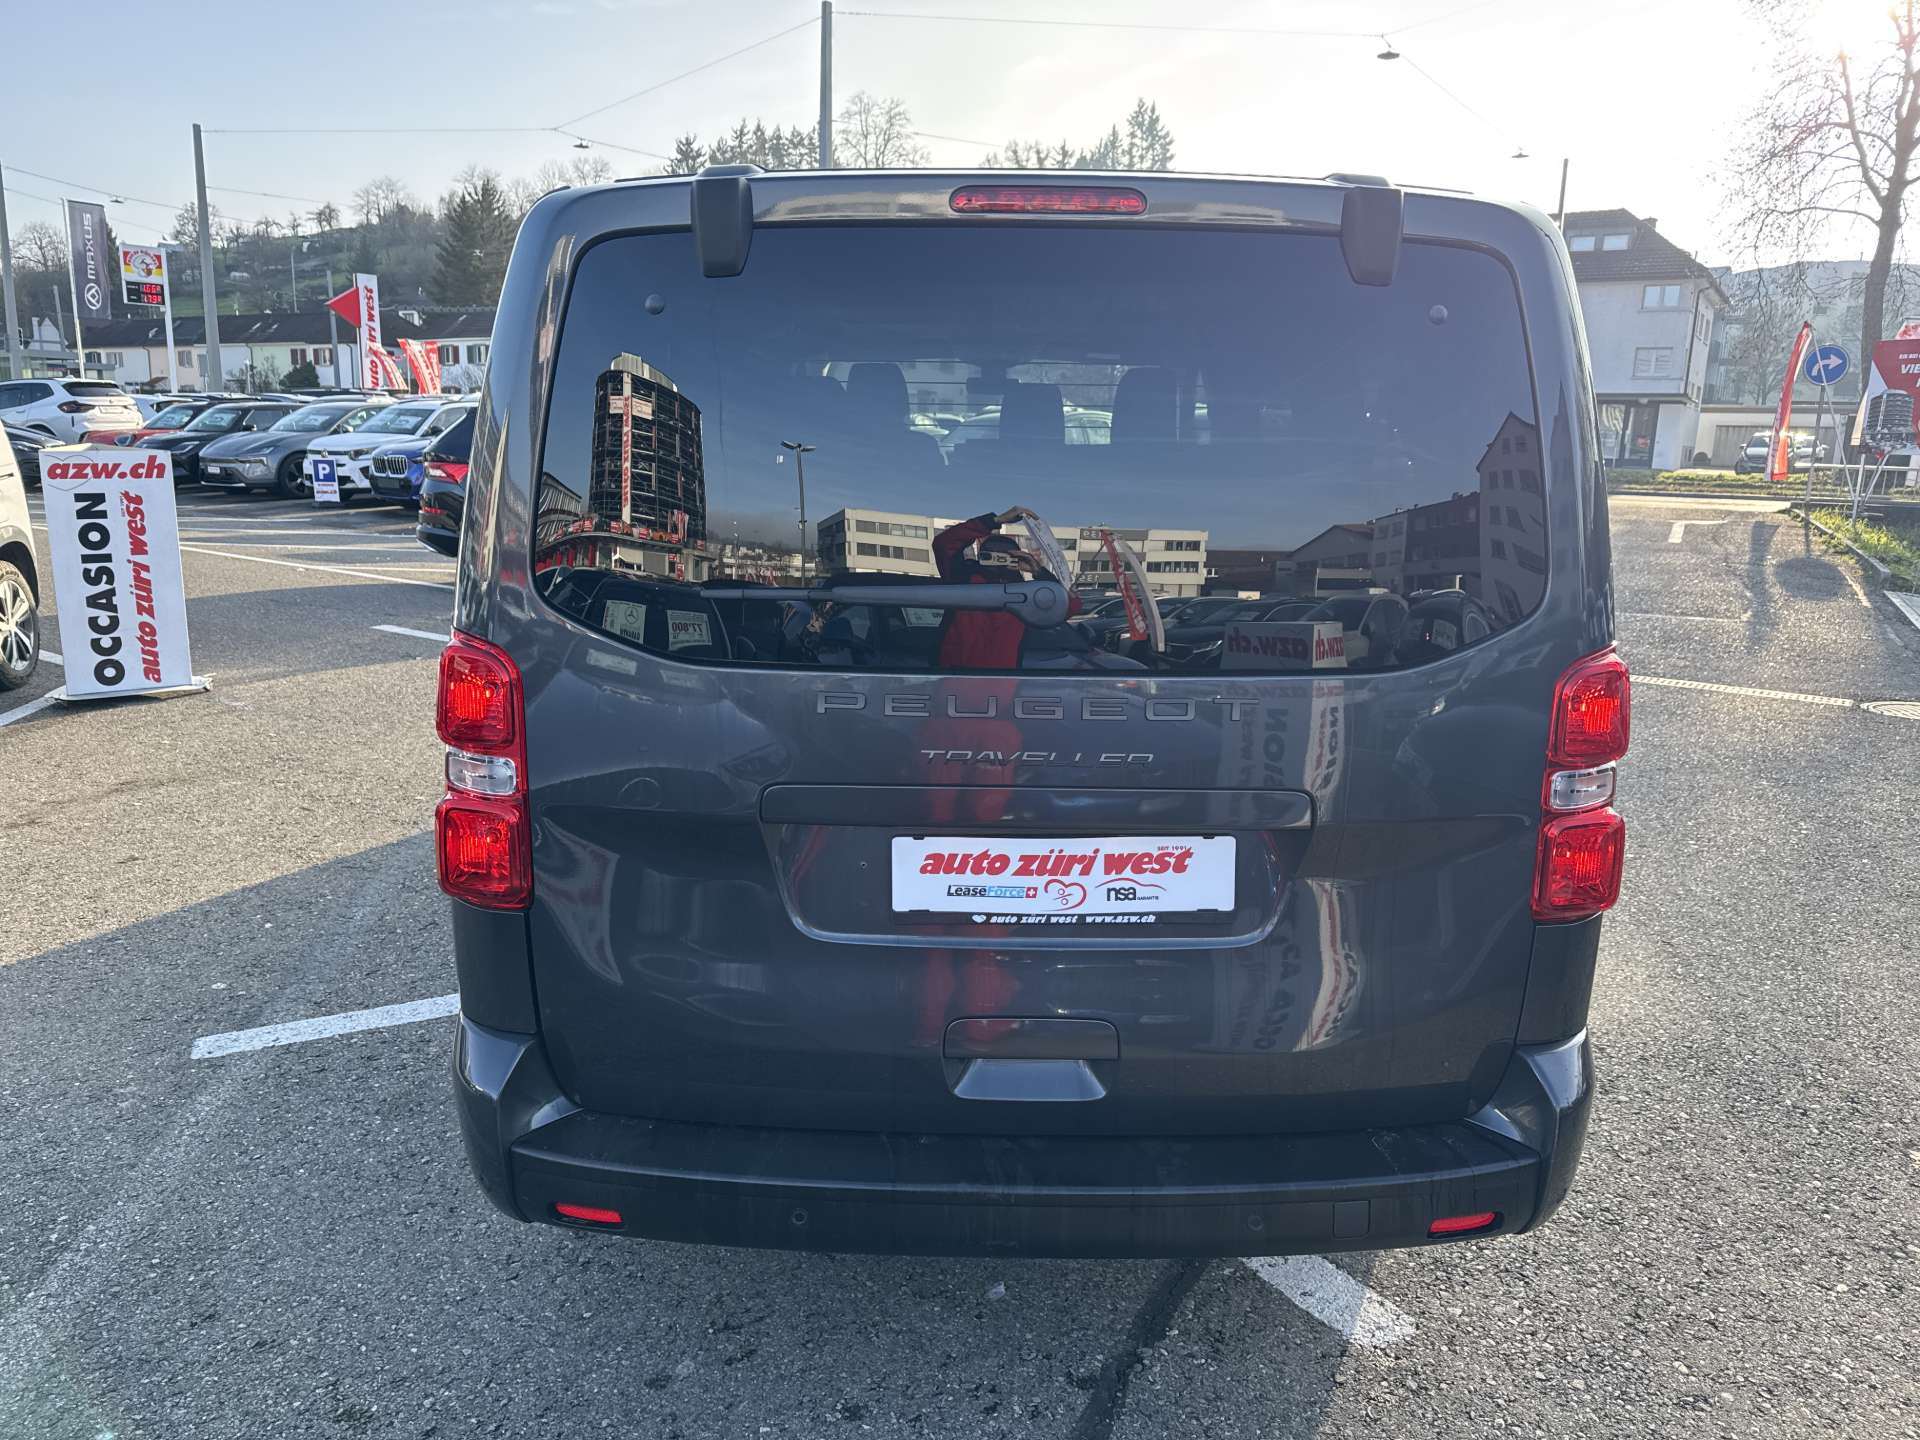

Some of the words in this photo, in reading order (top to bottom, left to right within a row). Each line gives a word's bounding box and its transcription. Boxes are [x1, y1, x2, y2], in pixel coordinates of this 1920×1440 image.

[82, 212, 96, 280] MAXUS
[364, 285, 376, 322] west
[47, 455, 166, 480] azw.ch
[318, 463, 330, 480] P
[120, 490, 150, 556] west
[73, 492, 126, 687] OCCASION
[126, 559, 156, 620] züri
[135, 620, 162, 683] auto
[816, 691, 1260, 722] PEUGEOT
[919, 748, 1155, 768] TRAVELLER
[918, 848, 1011, 876] auto
[1011, 848, 1101, 877] züri
[1103, 848, 1195, 876] west
[946, 885, 1026, 898] LeaseForce
[1106, 886, 1137, 902] nsa
[989, 915, 1018, 923] auto
[1019, 913, 1048, 923] züri
[1050, 915, 1079, 923] west
[1085, 914, 1156, 923] www.azw.ch
